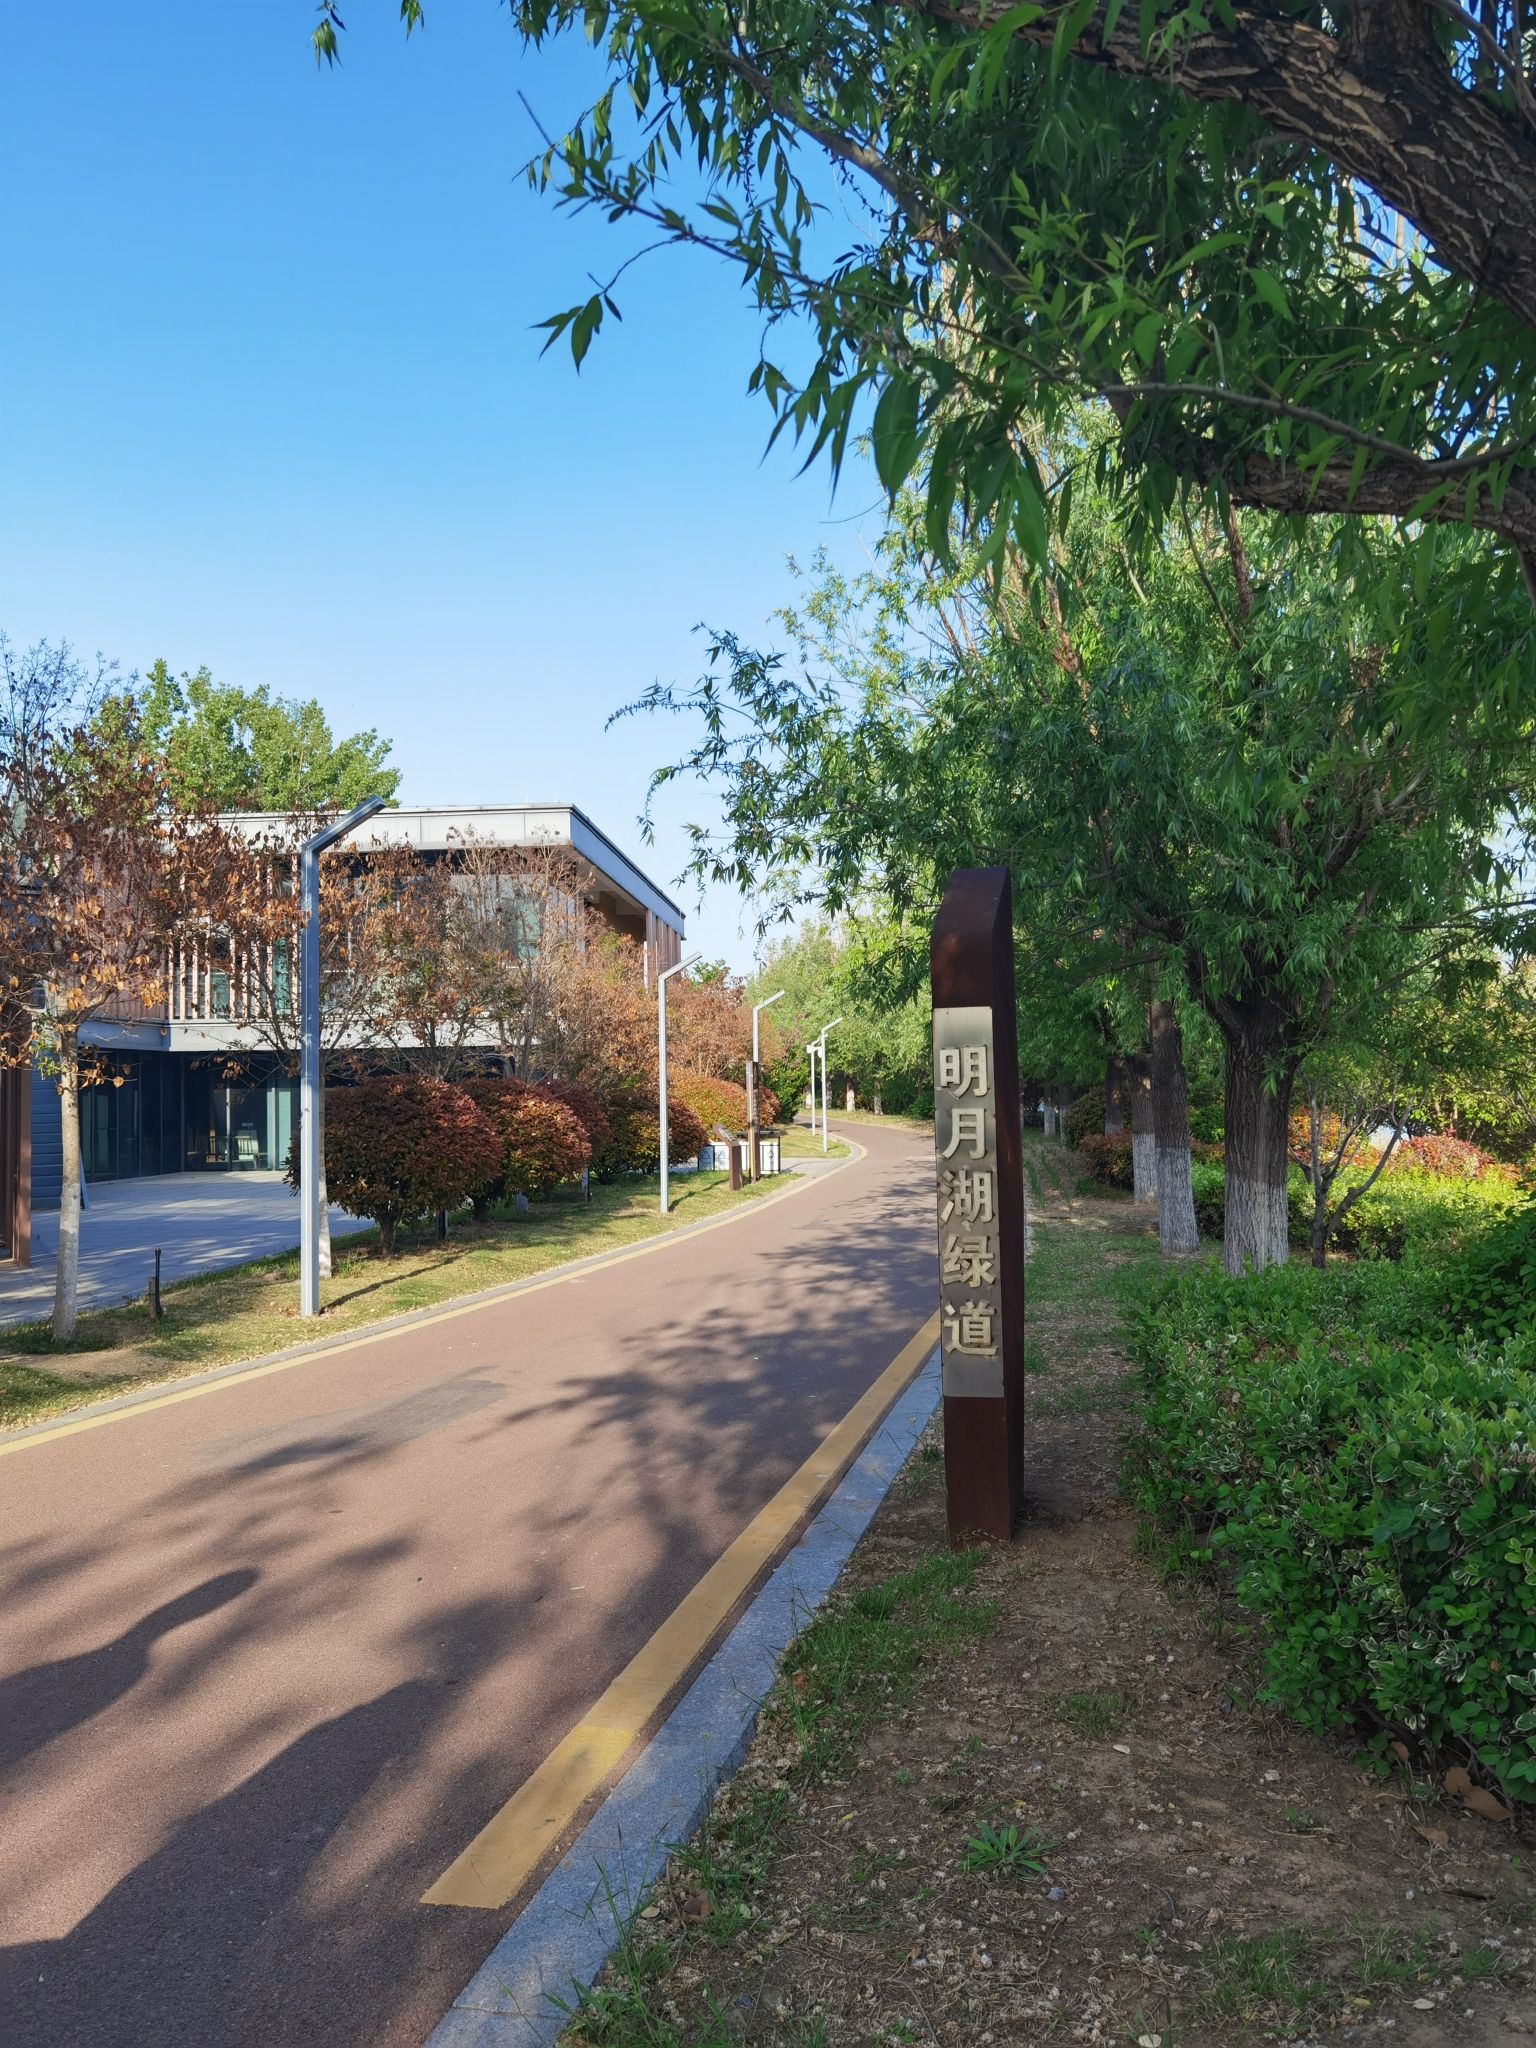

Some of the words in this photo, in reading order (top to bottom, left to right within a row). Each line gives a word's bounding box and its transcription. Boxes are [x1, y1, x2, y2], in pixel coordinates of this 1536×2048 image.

[939, 1045, 998, 1356] 明月湖绿道
